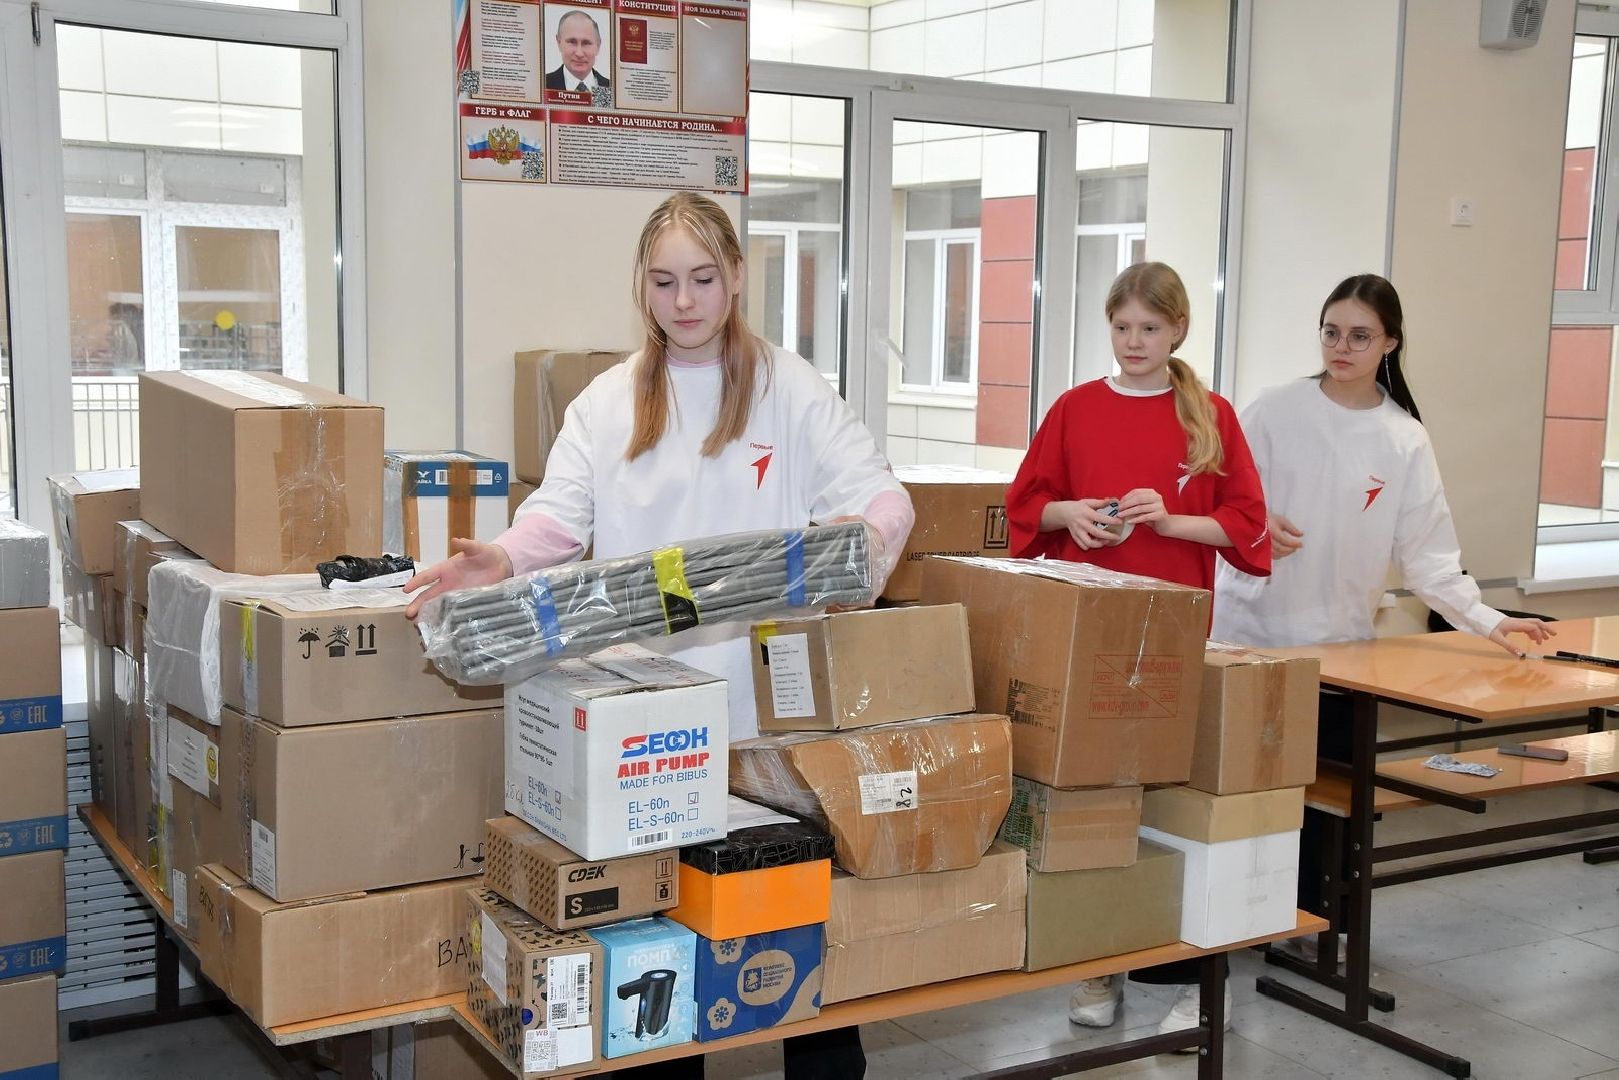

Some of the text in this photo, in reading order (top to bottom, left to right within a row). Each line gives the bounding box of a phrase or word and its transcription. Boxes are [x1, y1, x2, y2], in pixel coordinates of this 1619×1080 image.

[619, 0, 676, 12] КОНСТИТУЦИЯ
[700, 7, 720, 15] МАЛАЯ
[558, 92, 580, 100] Путин
[475, 107, 497, 116] ГЕРБ
[507, 109, 531, 118] ФЛАГ
[587, 115, 723, 132] С ЧЕГО НАЧИНАЕТСЯ РОДИНА...
[28, 705, 47, 724] EAC
[621, 727, 708, 758] SECOH
[617, 752, 710, 778] AIR PUMP
[620, 768, 708, 791] MADE FOR BIBUS
[628, 797, 670, 814] EL-60n
[628, 811, 685, 831] EL-S-60n
[35, 824, 55, 845] EAC
[568, 864, 607, 883] CDEK
[570, 897, 583, 915] S
